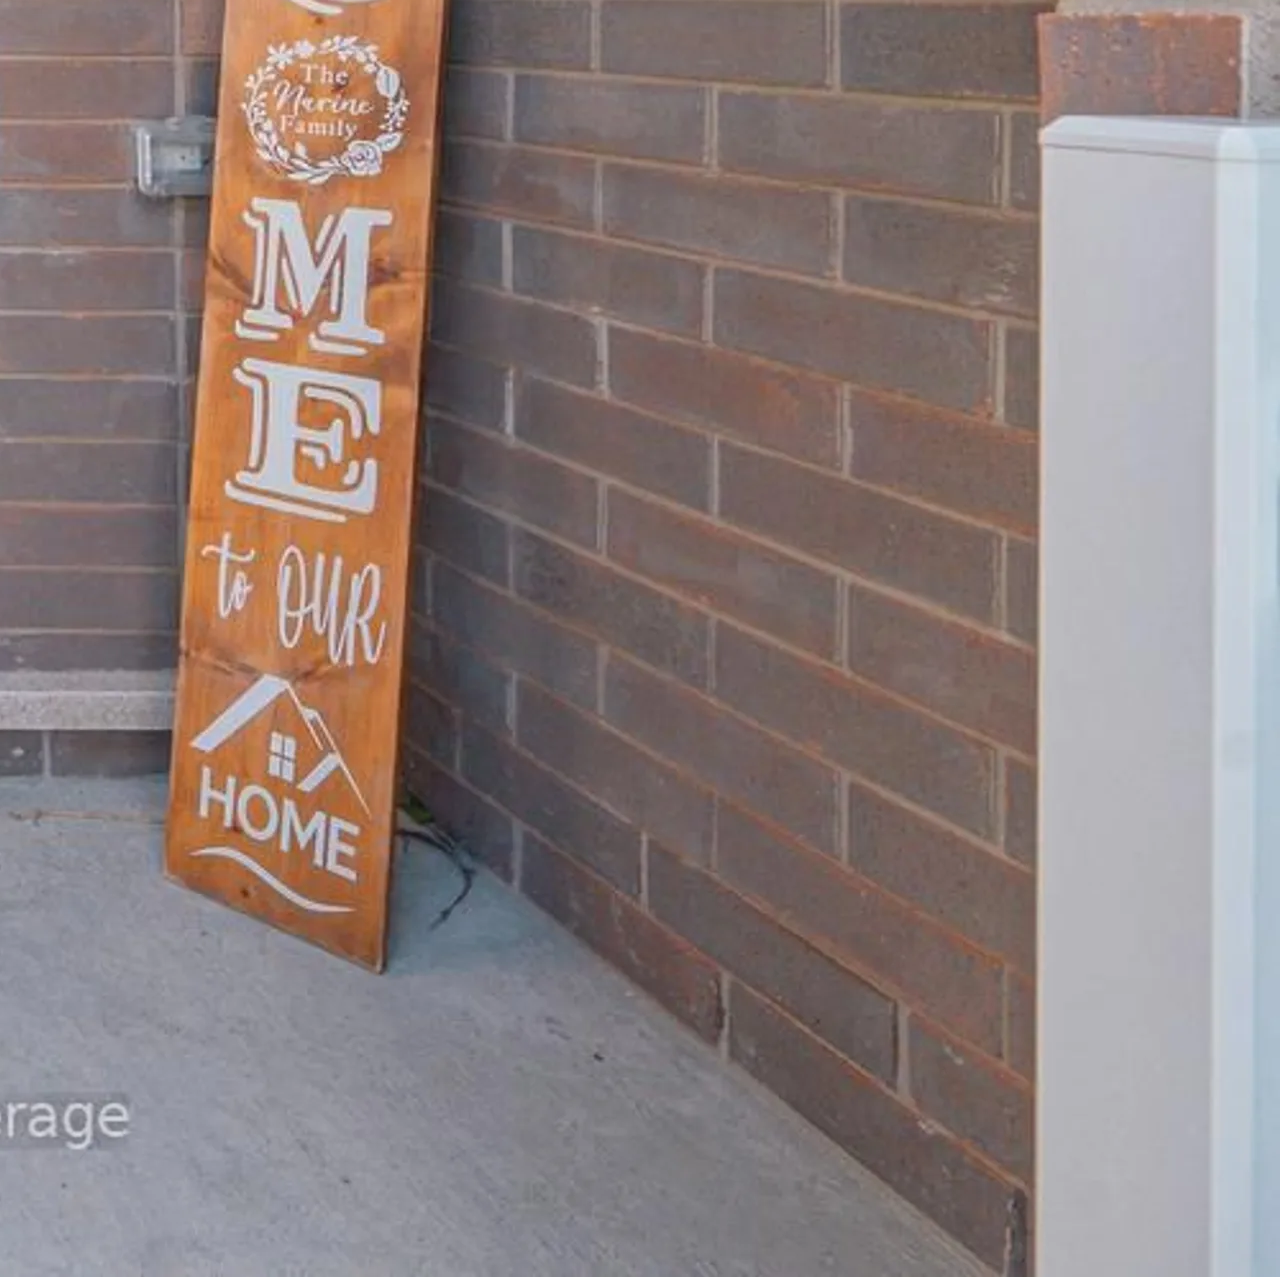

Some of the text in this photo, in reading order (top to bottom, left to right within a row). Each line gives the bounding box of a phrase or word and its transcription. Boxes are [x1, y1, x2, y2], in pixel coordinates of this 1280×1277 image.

[299, 62, 350, 86] The
[279, 113, 358, 142] Family
[201, 531, 388, 667] to OUR
[197, 765, 361, 883] HOME
